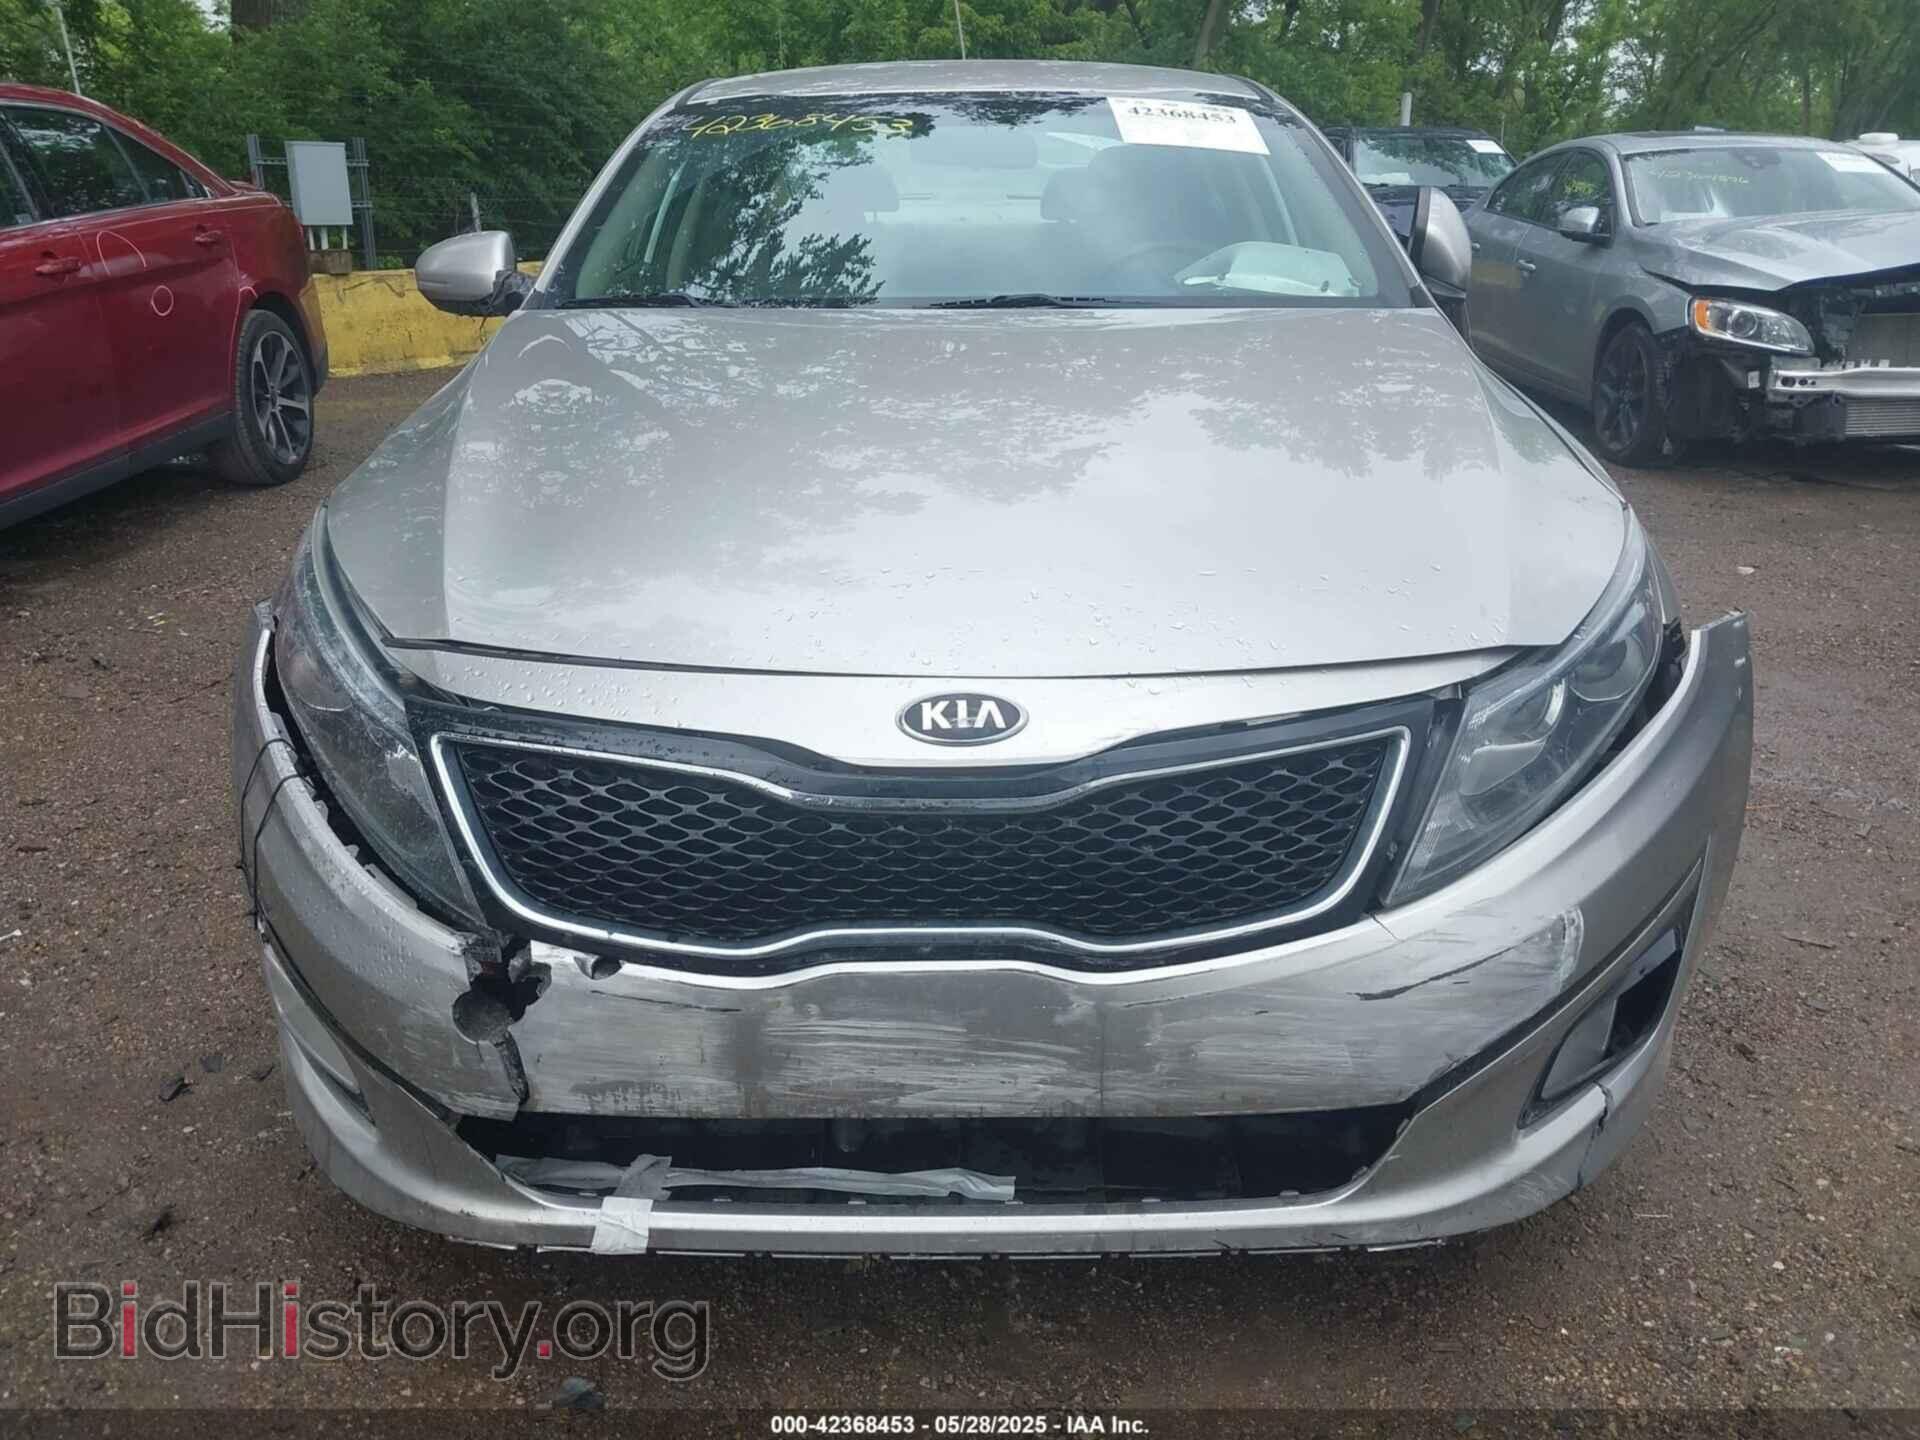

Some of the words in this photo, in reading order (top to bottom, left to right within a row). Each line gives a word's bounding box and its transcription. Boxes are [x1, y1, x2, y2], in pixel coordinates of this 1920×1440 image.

[682, 113, 913, 138] 42368453
[1128, 106, 1237, 124] 42368453
[920, 700, 1006, 730] KIA
